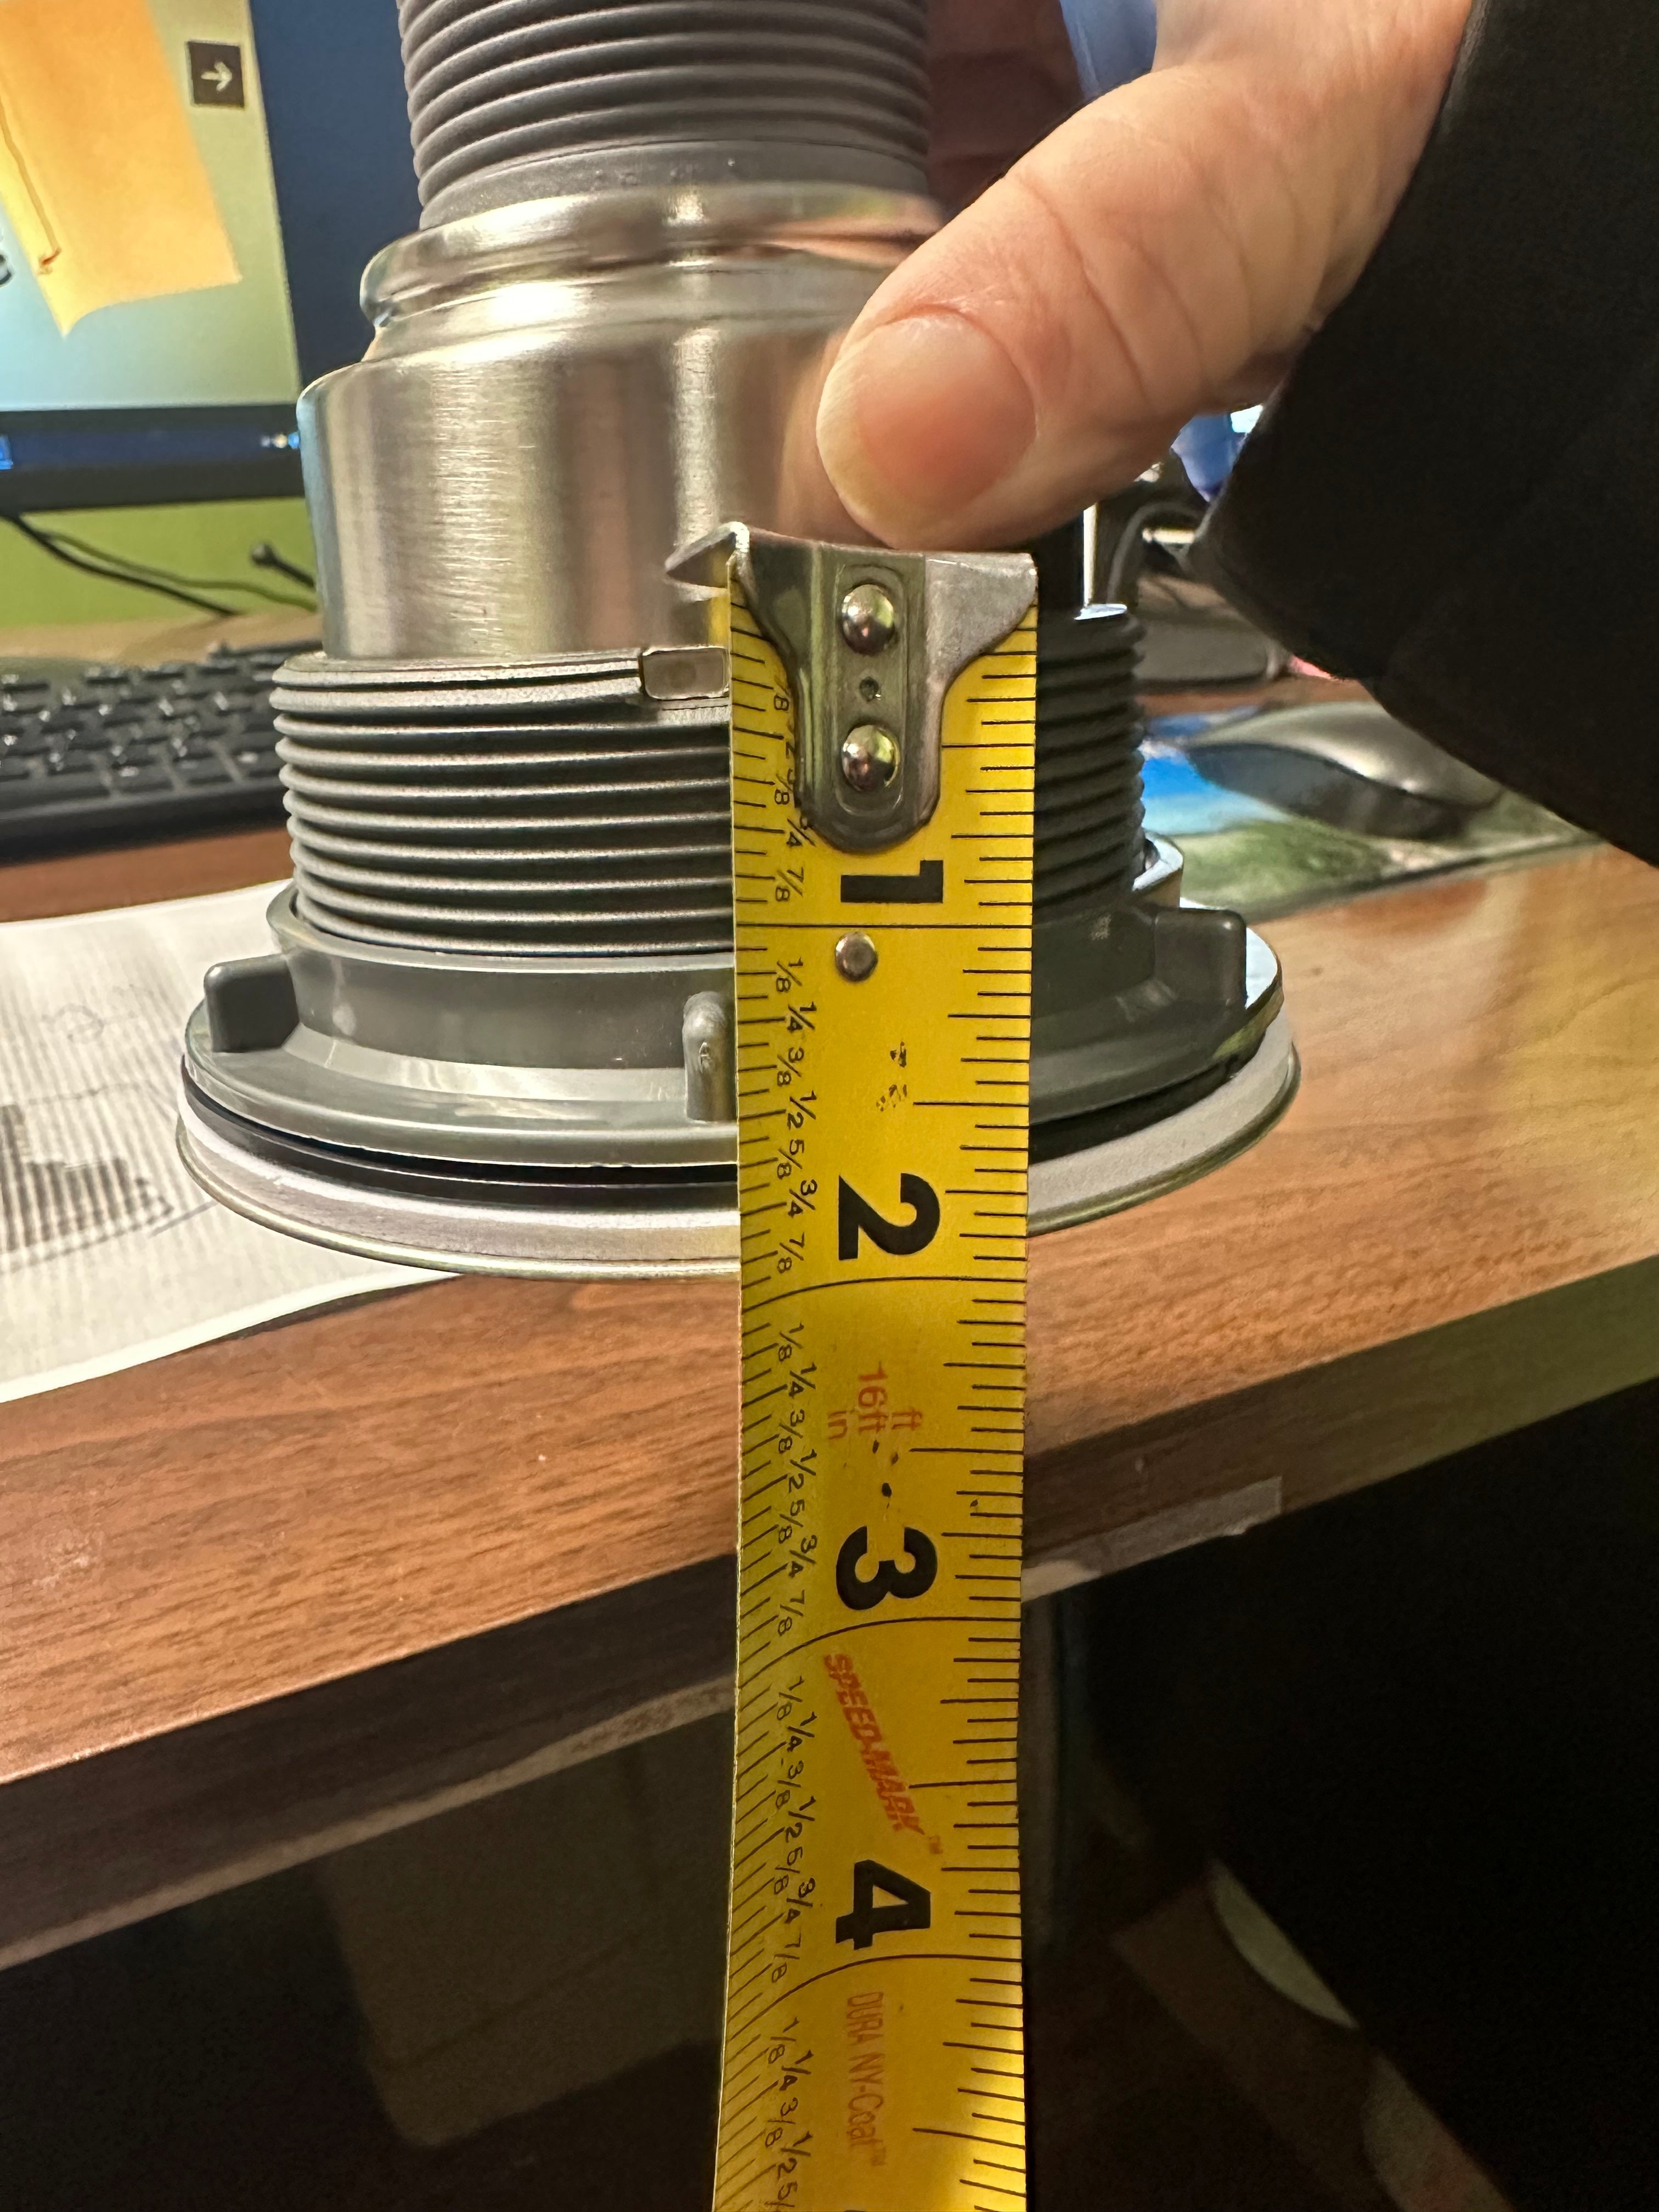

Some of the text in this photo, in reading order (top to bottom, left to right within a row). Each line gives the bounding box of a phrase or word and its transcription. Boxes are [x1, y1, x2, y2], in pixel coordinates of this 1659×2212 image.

[776, 867, 804, 902] 7/8
[840, 860, 944, 904] 1
[776, 957, 804, 992] 1/8
[787, 1001, 817, 1032] 1/4
[777, 1047, 804, 1086] 3/8
[787, 1090, 817, 1130] 1/2
[777, 1139, 804, 1180] 5/8
[788, 1179, 817, 1217] 3/4
[838, 1173, 940, 1260] 2
[777, 1233, 805, 1273] 7/8
[778, 1322, 804, 1362] 1/8
[788, 1362, 817, 1398] 1/4
[778, 1409, 804, 1453] 3/8
[788, 1448, 817, 1493] 1/2
[777, 1499, 805, 1544] 5/8
[788, 1535, 817, 1577] 3/4
[836, 1526, 938, 1610] 3
[777, 1589, 805, 1635] 7/8
[777, 1676, 804, 1720] 1/8
[787, 1711, 817, 1752] 1/4
[775, 1760, 804, 1809] 3/8
[785, 1796, 816, 1843] 1/2
[774, 1847, 803, 1894] 5/8
[785, 1877, 816, 1924] 3/4
[836, 1859, 930, 1950] 4
[771, 1931, 801, 1983] 7/8
[768, 2017, 799, 2064] 1/8
[779, 2050, 813, 2091] 1/4
[765, 2097, 799, 2148] 3/8
[777, 2131, 813, 2180] 1/2
[765, 2181, 798, 2211] 5/
